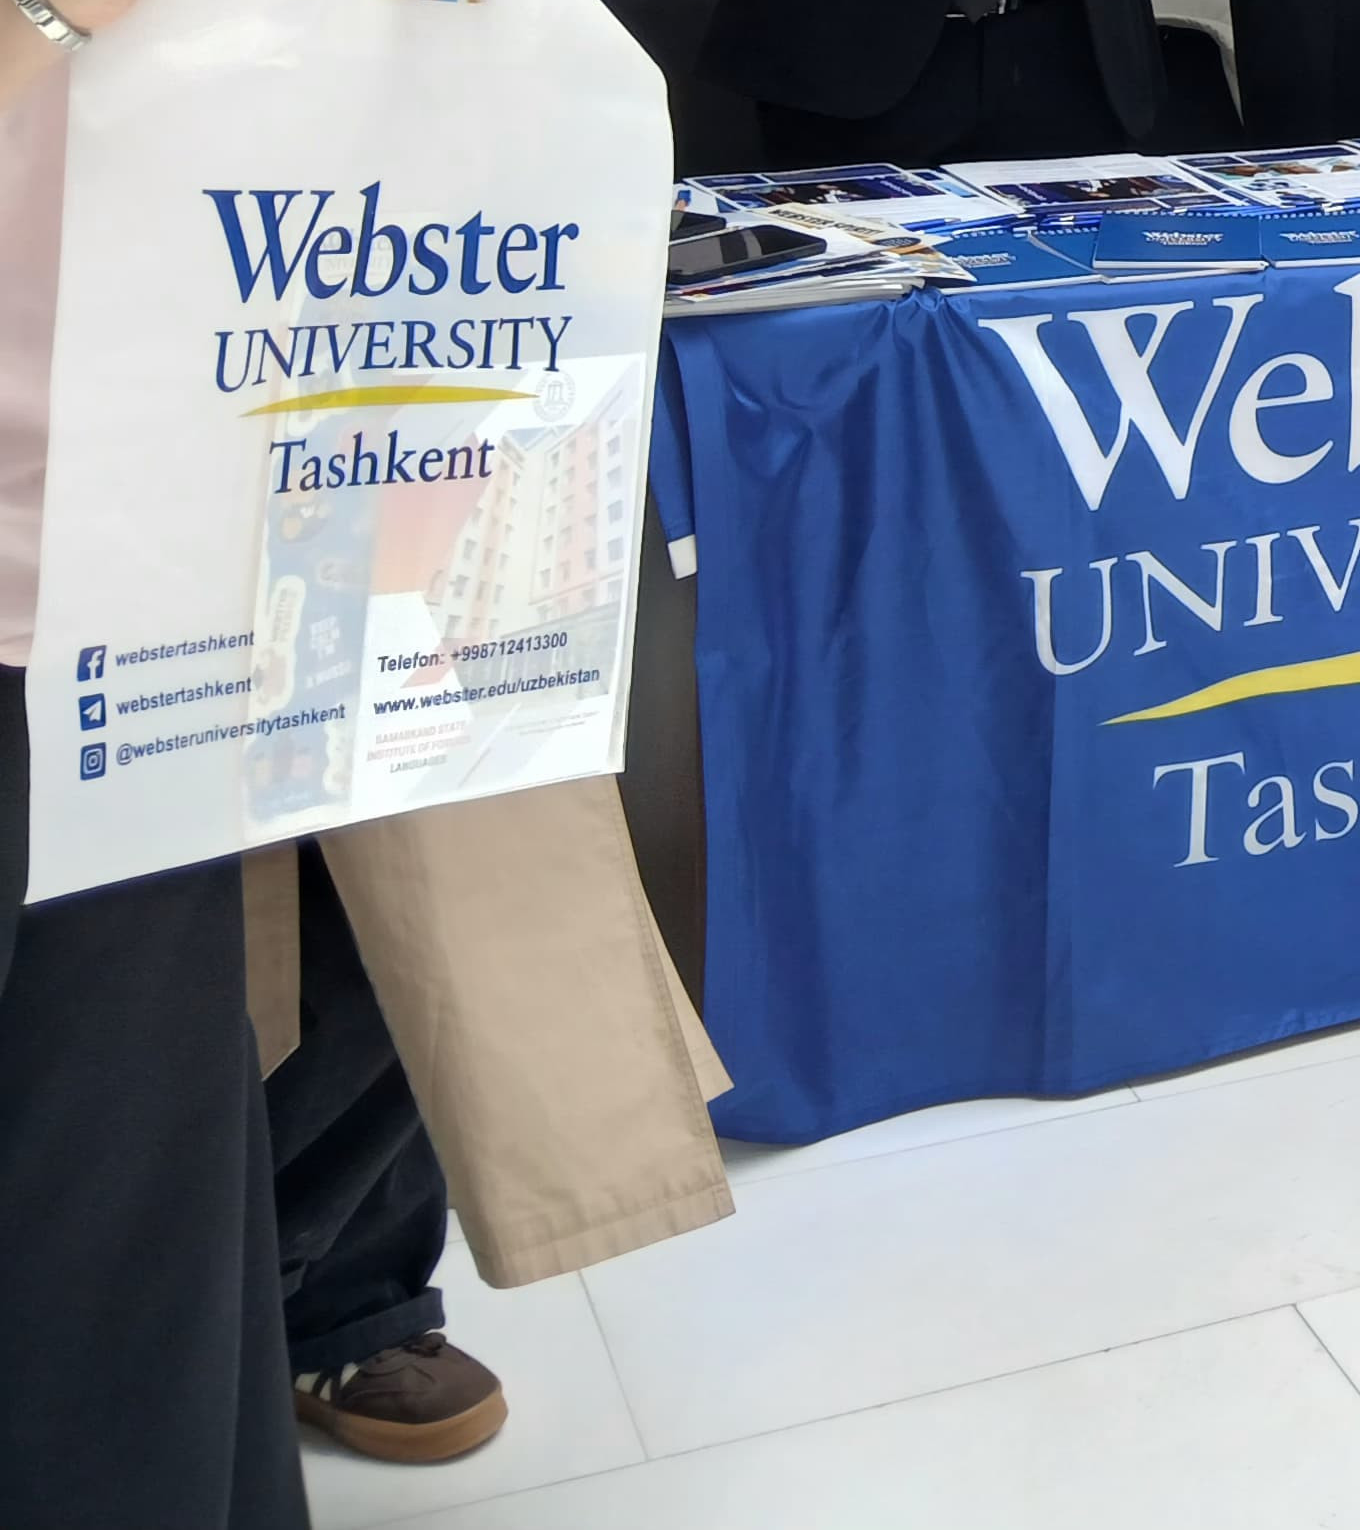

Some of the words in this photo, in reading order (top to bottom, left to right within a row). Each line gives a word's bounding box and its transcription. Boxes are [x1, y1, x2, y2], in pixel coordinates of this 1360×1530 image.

[203, 181, 579, 303] Webster
[213, 316, 573, 393] UNIVERSITY
[270, 430, 496, 495] Tashkent
[114, 629, 256, 668] webstertashkent
[377, 649, 446, 674] Telefon:
[450, 631, 569, 663] +998712413300
[115, 676, 253, 716] webstertashkent
[373, 667, 601, 716] www.webster.edu/uzbekistan
[115, 702, 346, 767] @websteruniversitytashkent
